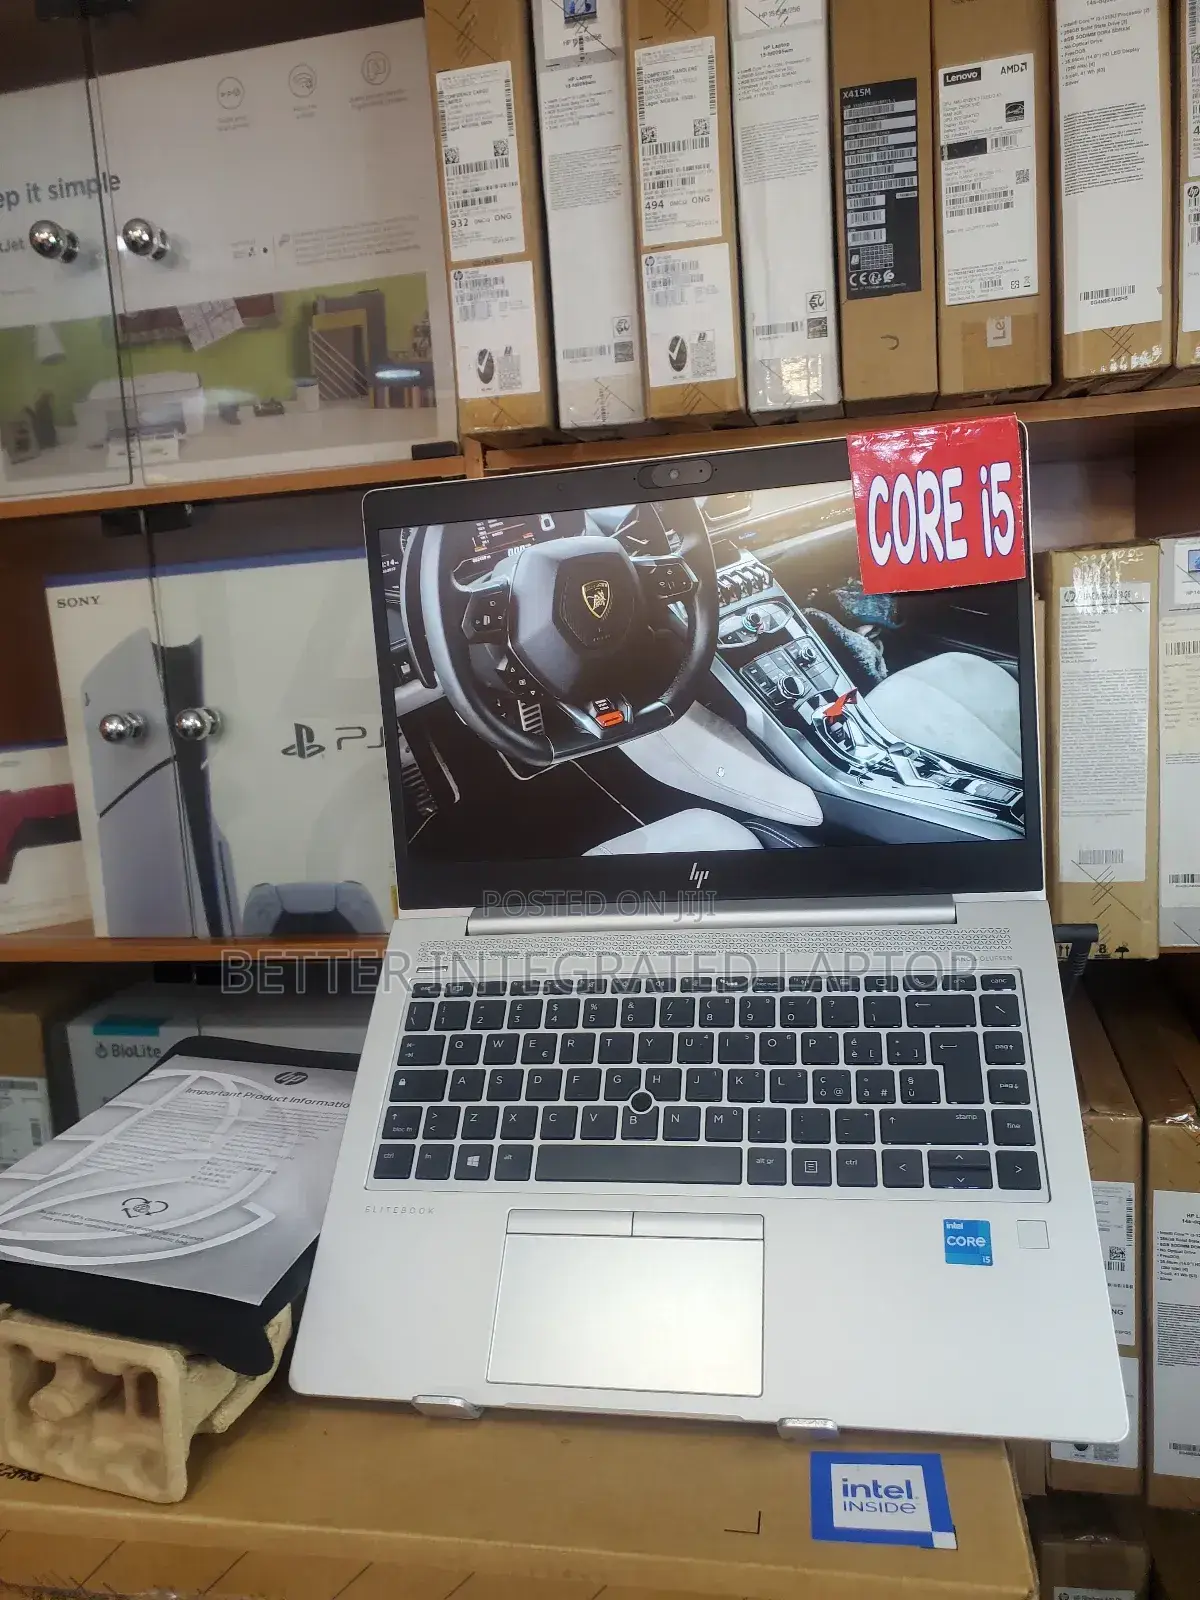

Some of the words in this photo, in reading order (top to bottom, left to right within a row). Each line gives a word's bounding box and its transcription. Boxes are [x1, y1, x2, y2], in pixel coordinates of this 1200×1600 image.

[1000, 64, 1020, 76] AMD
[946, 71, 978, 83] Lenovo
[842, 87, 872, 100] X415M
[26, 183, 41, 204] it
[48, 172, 121, 201] simple
[645, 199, 664, 210] 494
[691, 194, 711, 204] ONG
[494, 212, 512, 222] ONG
[450, 218, 469, 229] 932
[868, 465, 968, 567] CORE
[979, 461, 1015, 558] i5
[56, 595, 100, 609] SONY
[768, 1039, 776, 1047] O
[809, 1039, 816, 1047] P
[111, 1043, 162, 1059] BioLite
[496, 1076, 502, 1084] S
[614, 1075, 621, 1083] G
[653, 1075, 660, 1083] H
[778, 1077, 784, 1085] L
[185, 1087, 242, 1098] Important
[243, 1091, 290, 1103] Product
[834, 1088, 843, 1096] @
[549, 1113, 557, 1121] C
[590, 1113, 597, 1121] V
[630, 1116, 637, 1124] B
[672, 1114, 679, 1122] N
[714, 1115, 723, 1123] M
[955, 1113, 978, 1121] stamp
[364, 1205, 436, 1215] ELITEBOOK
[945, 1221, 964, 1230] intel
[982, 1255, 991, 1264] i5
[841, 1477, 914, 1500] intel
